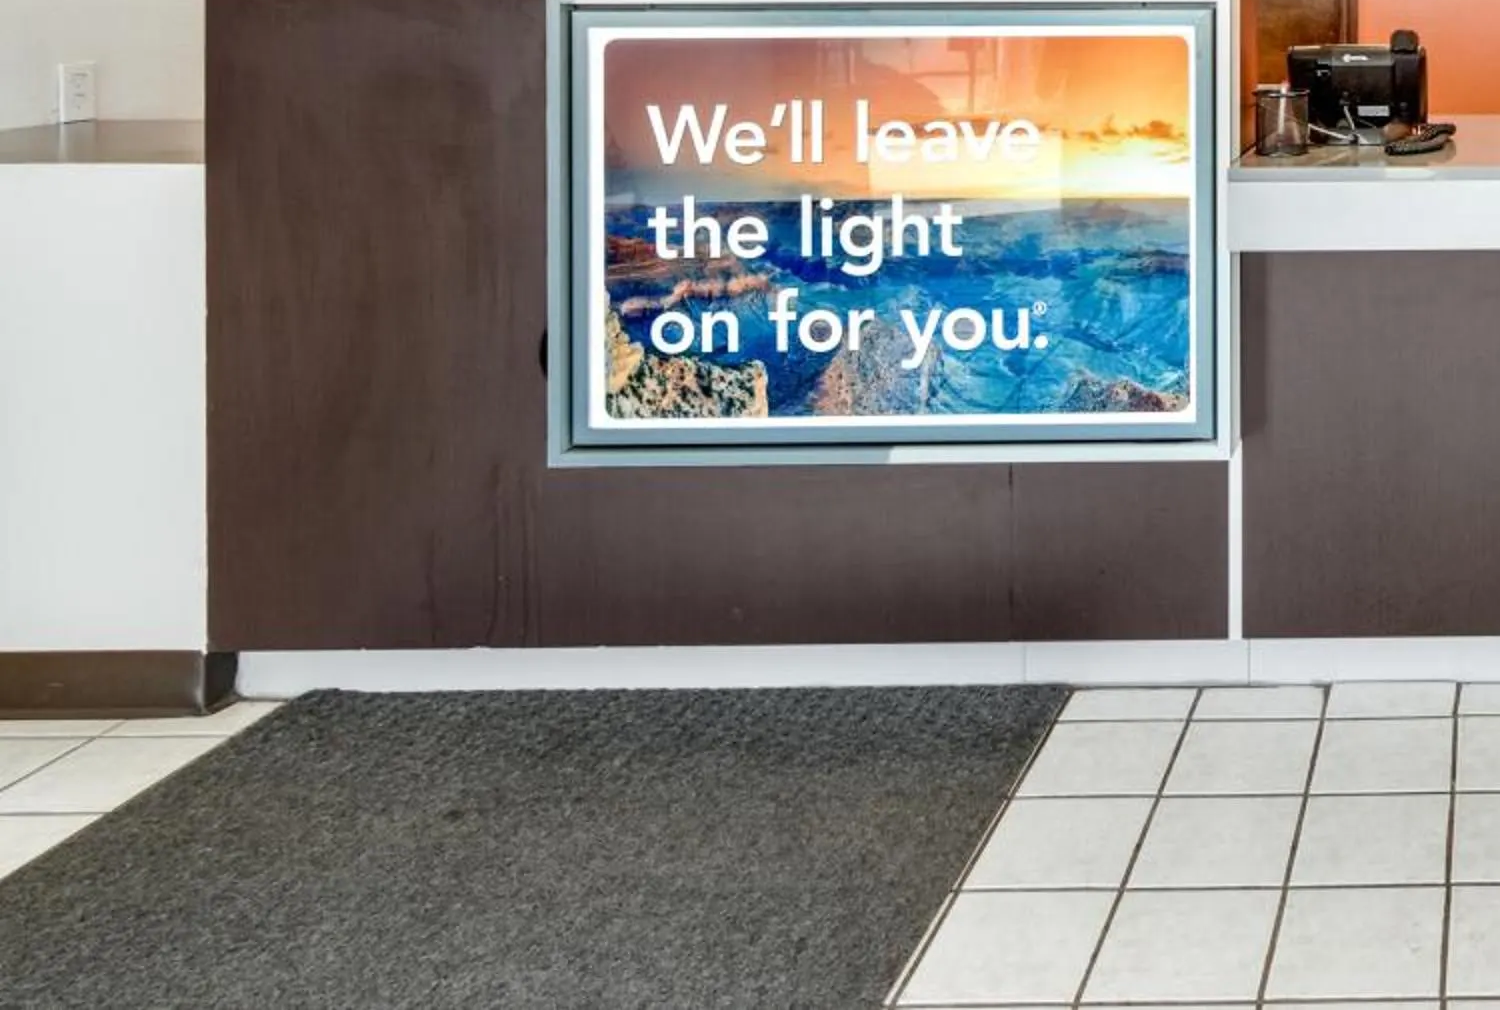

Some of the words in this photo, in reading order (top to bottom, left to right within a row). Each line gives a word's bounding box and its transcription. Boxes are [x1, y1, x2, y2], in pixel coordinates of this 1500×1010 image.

[645, 99, 824, 165] We'll
[856, 99, 1041, 164] leave
[647, 194, 769, 260] the
[800, 193, 964, 277] light
[650, 305, 740, 354] on
[768, 287, 876, 353] for
